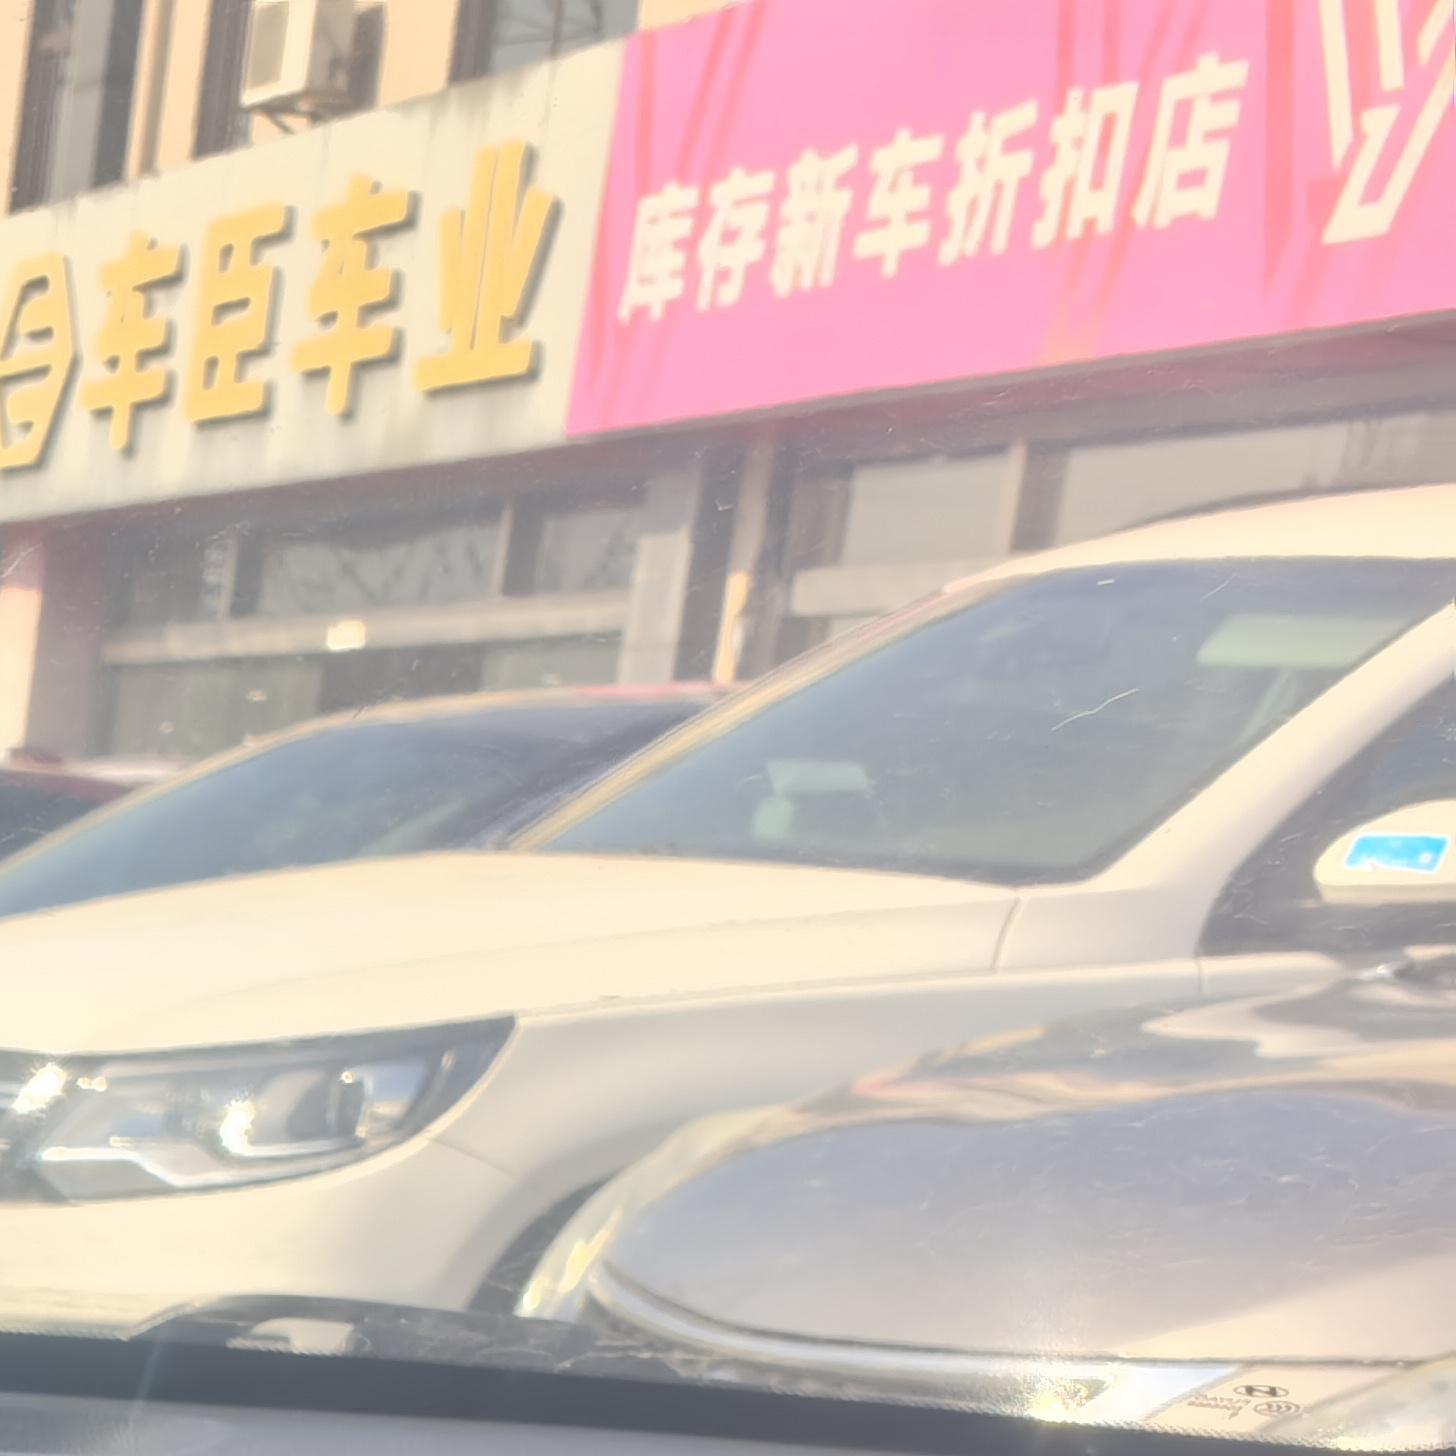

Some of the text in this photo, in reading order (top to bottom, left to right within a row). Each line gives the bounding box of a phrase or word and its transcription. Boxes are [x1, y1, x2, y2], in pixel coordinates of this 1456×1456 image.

[82, 137, 558, 452] 车臣车业
[618, 52, 1248, 324] 库存新车折扣店
